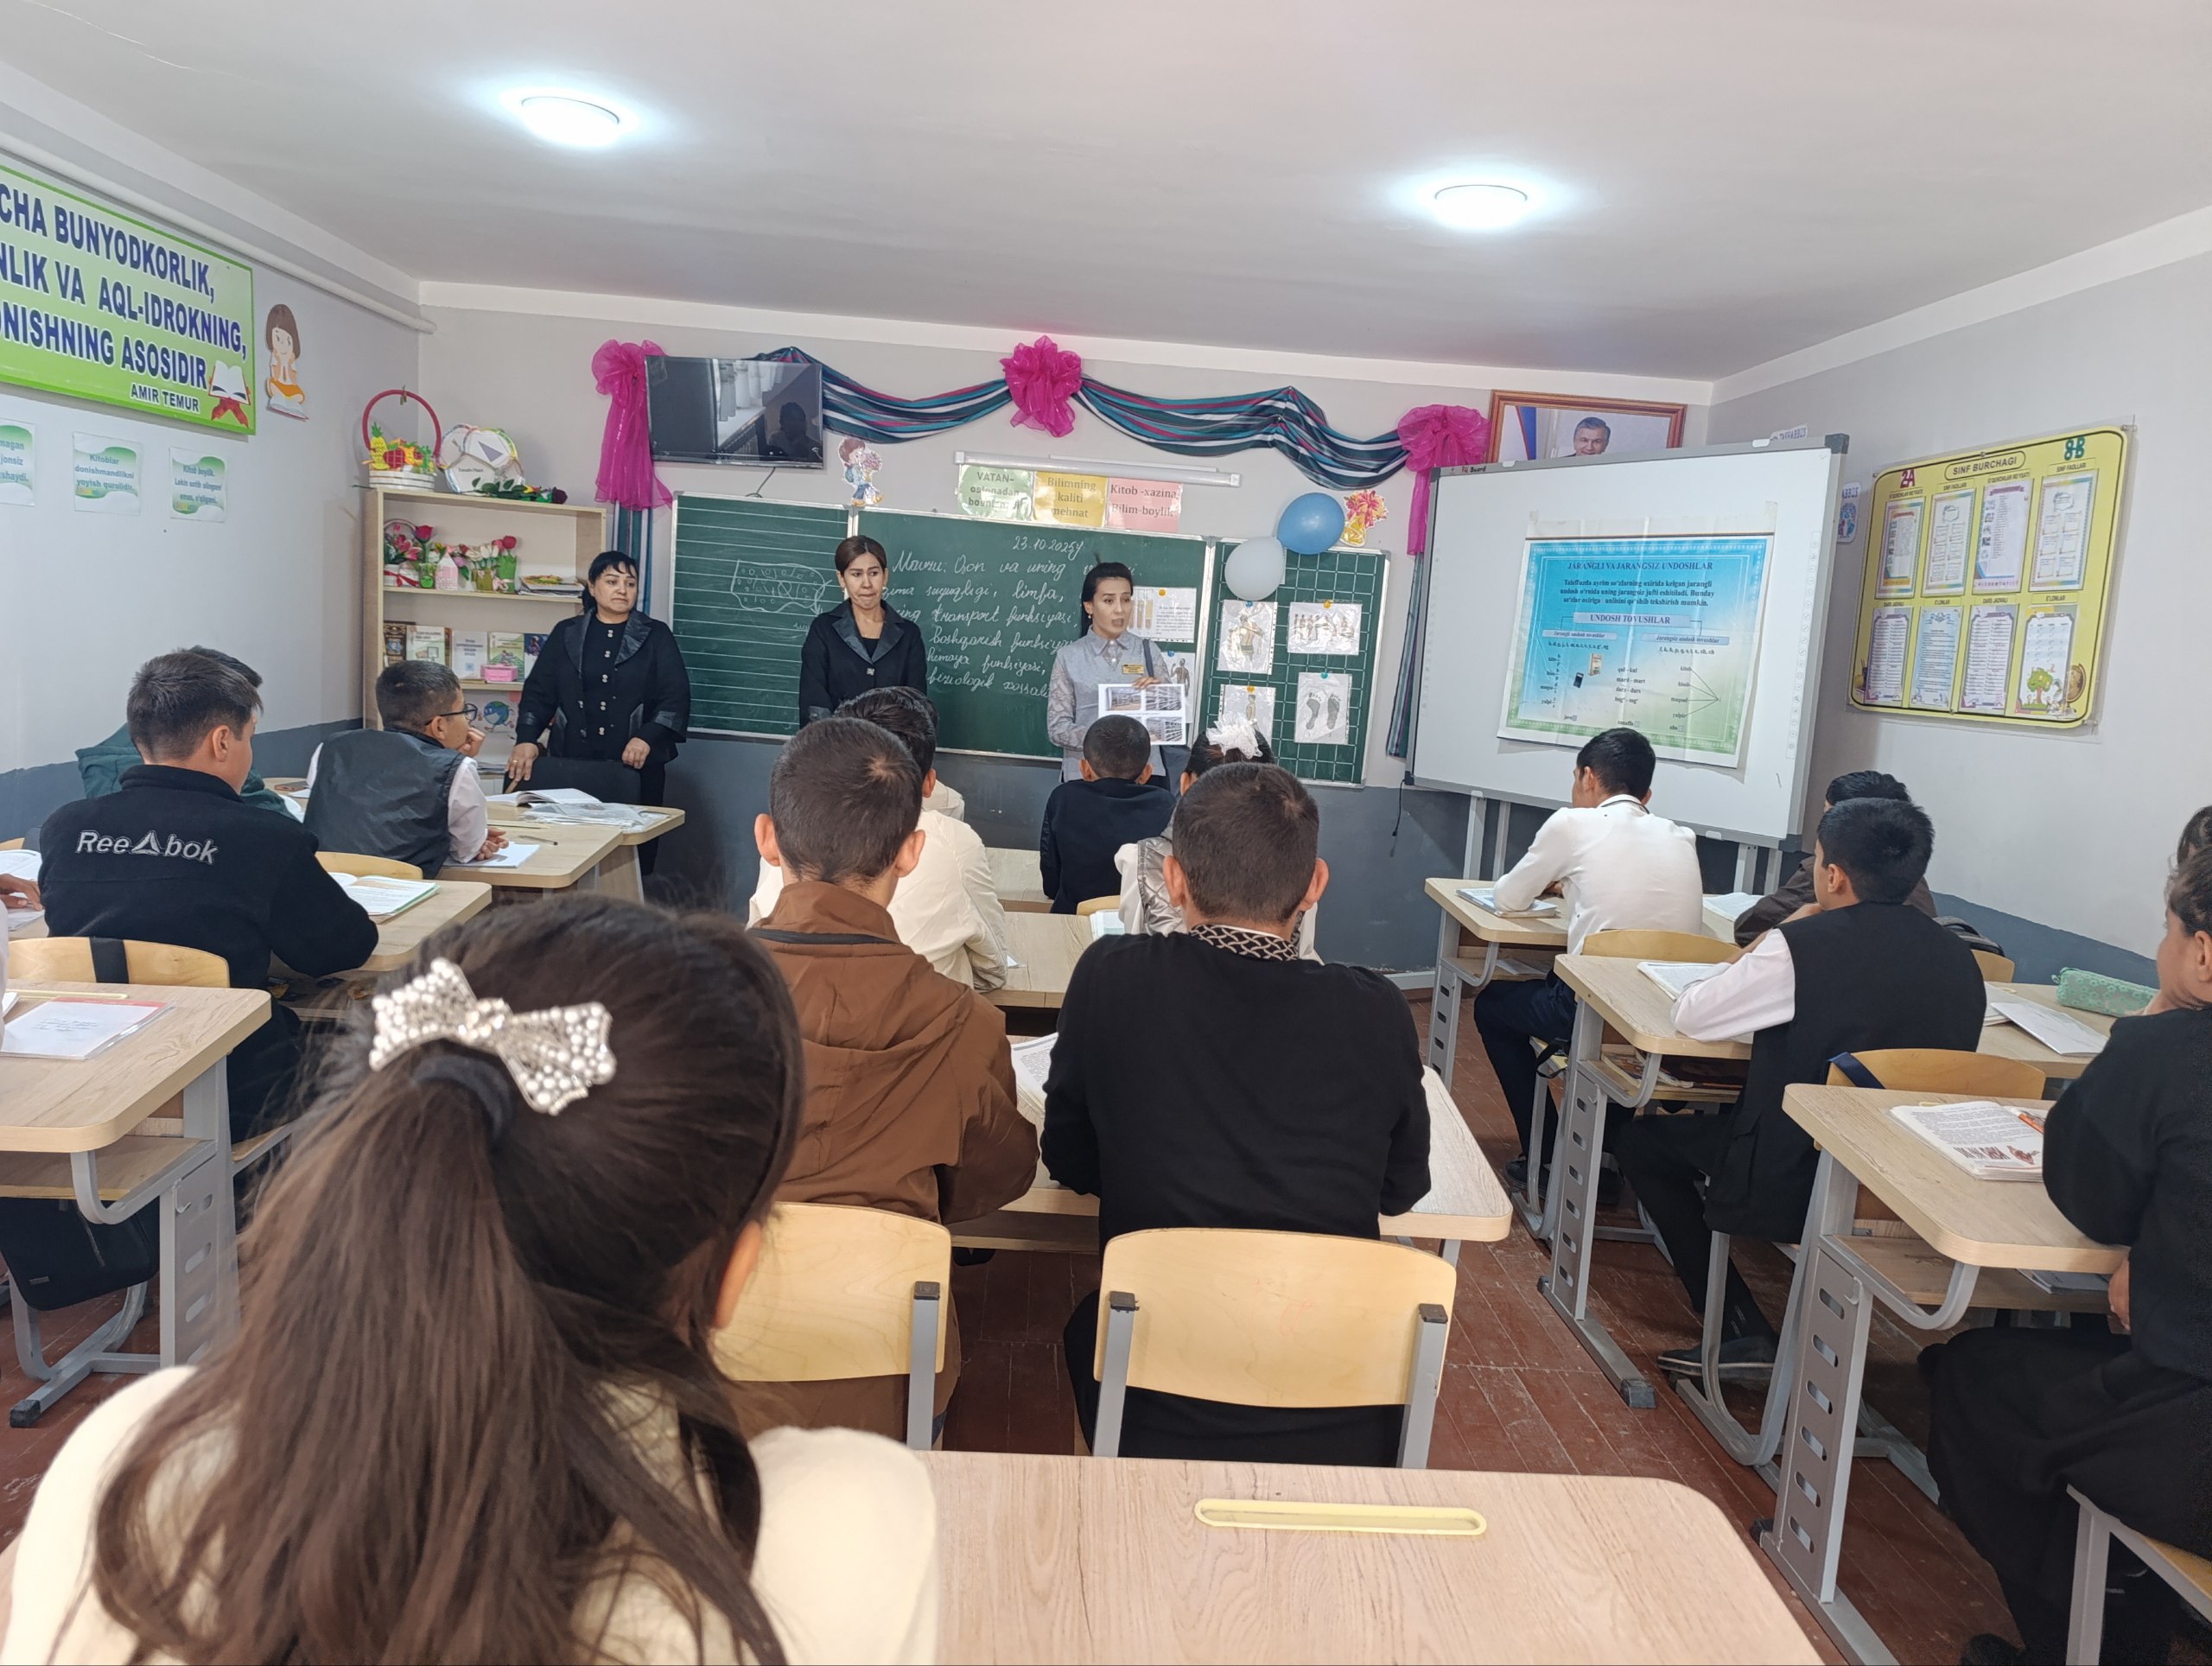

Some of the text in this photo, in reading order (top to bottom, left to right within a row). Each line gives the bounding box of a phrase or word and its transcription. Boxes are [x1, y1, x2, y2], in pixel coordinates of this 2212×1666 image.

[54, 205, 214, 304] BUNYODKORLIK,
[54, 260, 86, 305] VA
[99, 277, 247, 360] AQL-IDROKNING,
[121, 336, 207, 390] ASOSIDIR
[130, 384, 200, 412] AMIR TEMUR
[1952, 456, 2018, 476] SINF BURCHAGI
[977, 471, 1014, 483] VATAN-
[1900, 469, 1916, 489] 2A
[1047, 476, 1096, 492] Bilimning
[1110, 484, 1138, 495] Kitob
[1058, 491, 1084, 503] kaliti
[1051, 506, 1089, 518] mehnat
[999, 562, 1020, 573] va
[1567, 562, 1605, 570] JARANGLI
[1616, 562, 1661, 570] JARANGSIZ
[1662, 562, 1713, 570] UNDOSHLAR
[1687, 580, 1713, 589] jarangli
[1690, 589, 1715, 599] Bunday
[931, 603, 1000, 626] transport
[1590, 614, 1671, 625] UNDOSH TOVUSHLAR
